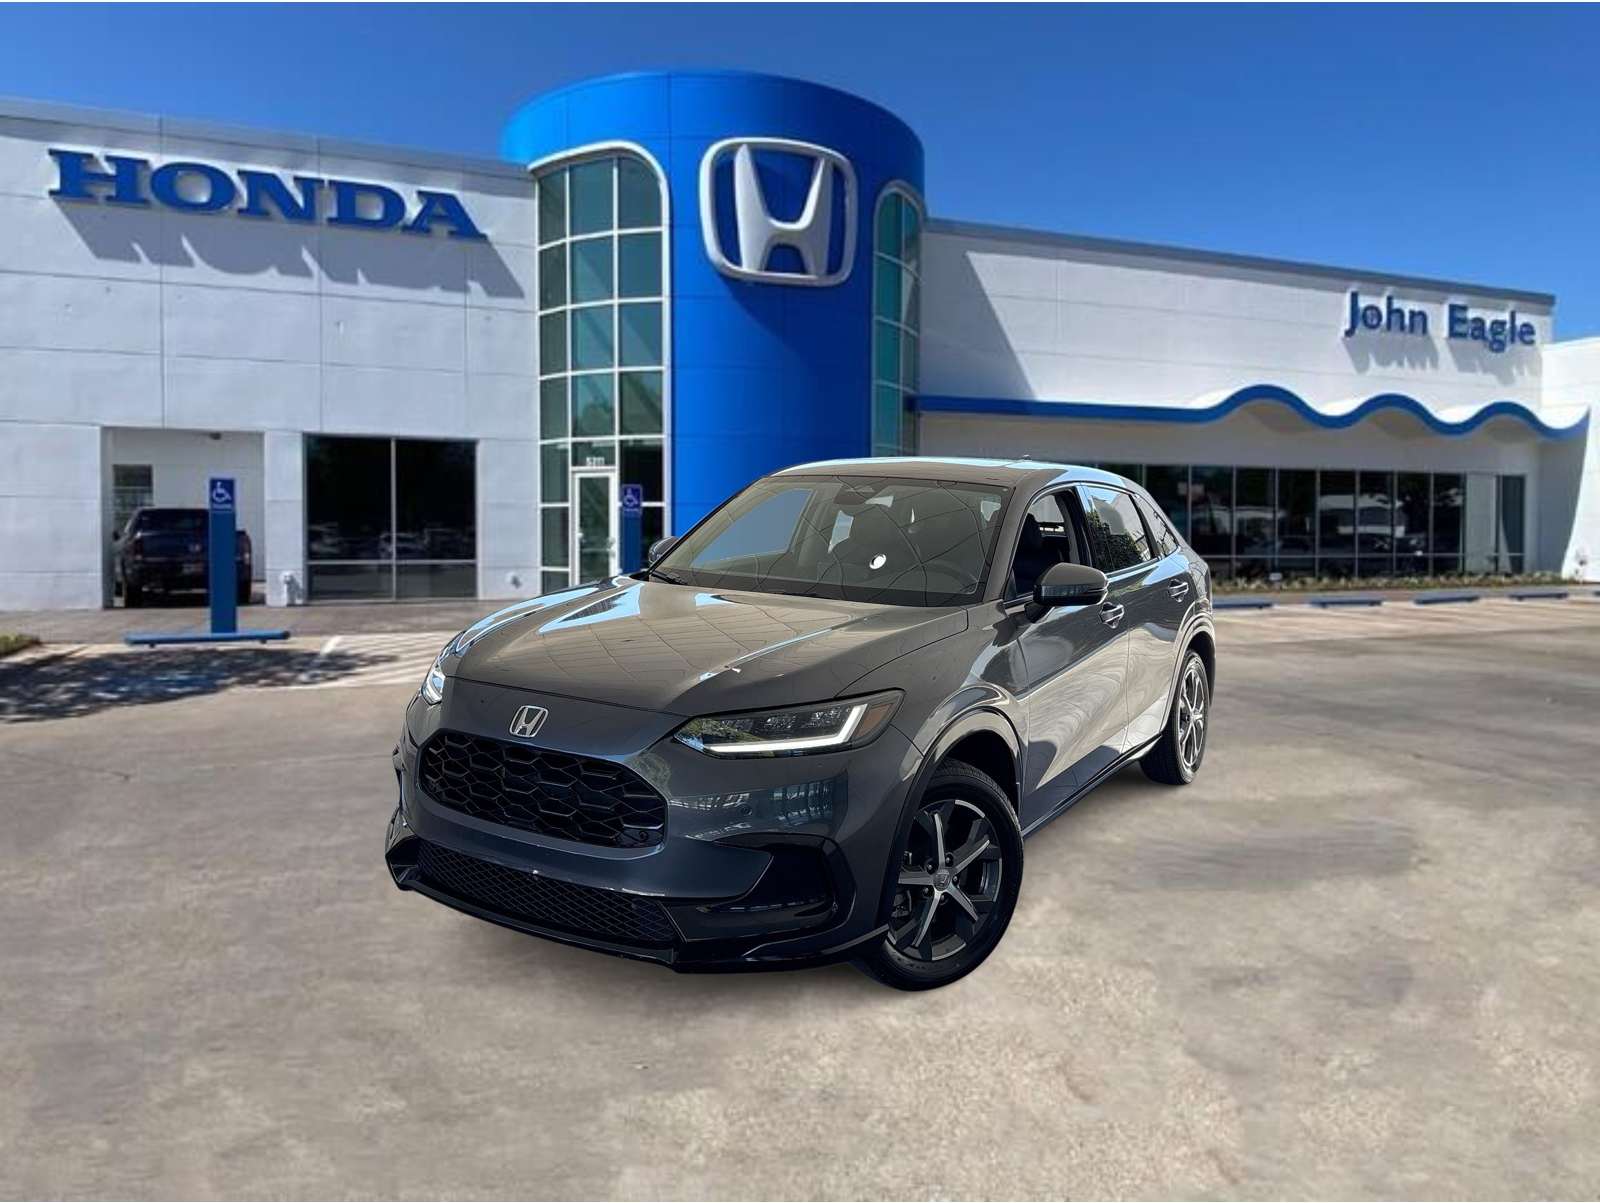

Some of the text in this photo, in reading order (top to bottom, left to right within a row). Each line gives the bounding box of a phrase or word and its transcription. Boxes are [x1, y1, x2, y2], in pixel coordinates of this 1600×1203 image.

[48, 148, 487, 240] HONDA
[1344, 291, 1536, 353] John Eagle
